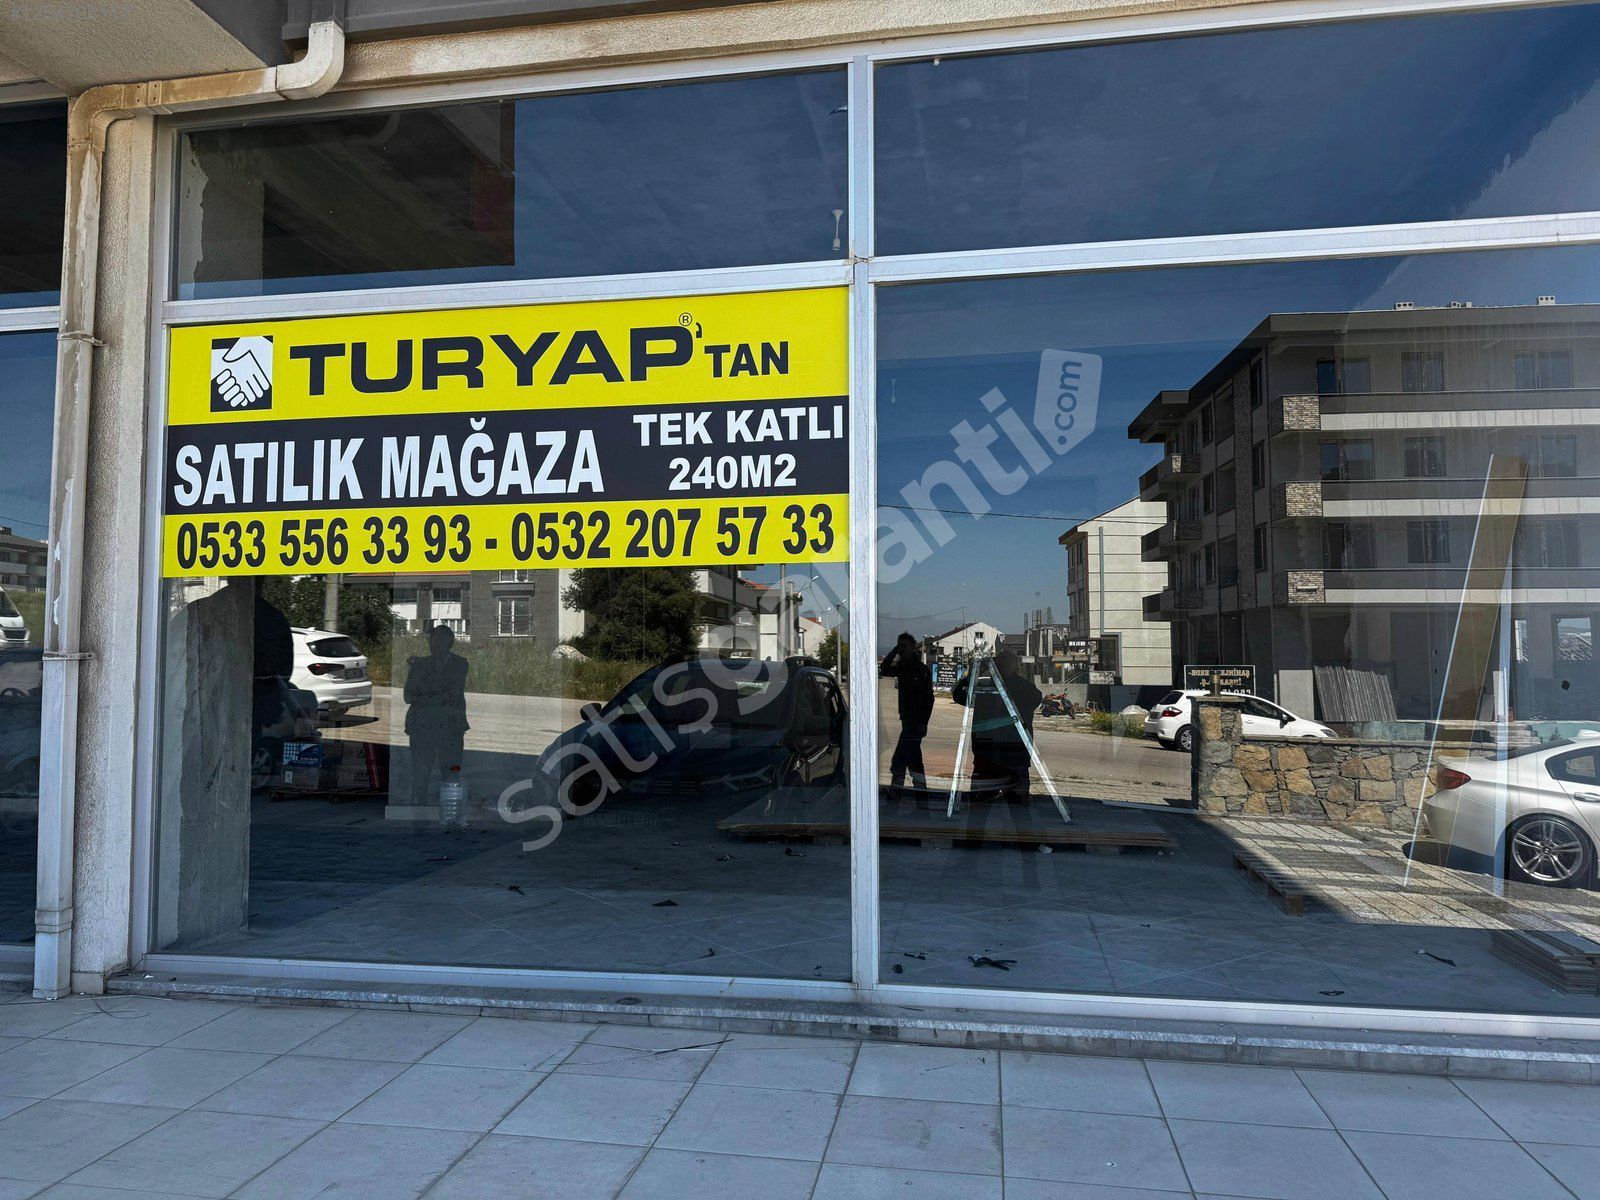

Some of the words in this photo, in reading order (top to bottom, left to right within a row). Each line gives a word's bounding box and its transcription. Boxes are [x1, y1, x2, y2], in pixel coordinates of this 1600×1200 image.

[632, 410, 715, 447] TEK
[726, 405, 845, 444] KATLI
[174, 436, 365, 506] SATILIK
[381, 417, 606, 500] MAĞAZA
[668, 453, 797, 491] 240M2
[177, 518, 266, 570] 0533
[280, 516, 349, 567] 556
[363, 514, 410, 565] 33
[424, 513, 472, 564] 93
[485, 538, 498, 550] -
[512, 510, 611, 562] 0532
[626, 506, 701, 559] 207
[716, 505, 767, 557] 57
[783, 503, 834, 555] 33
